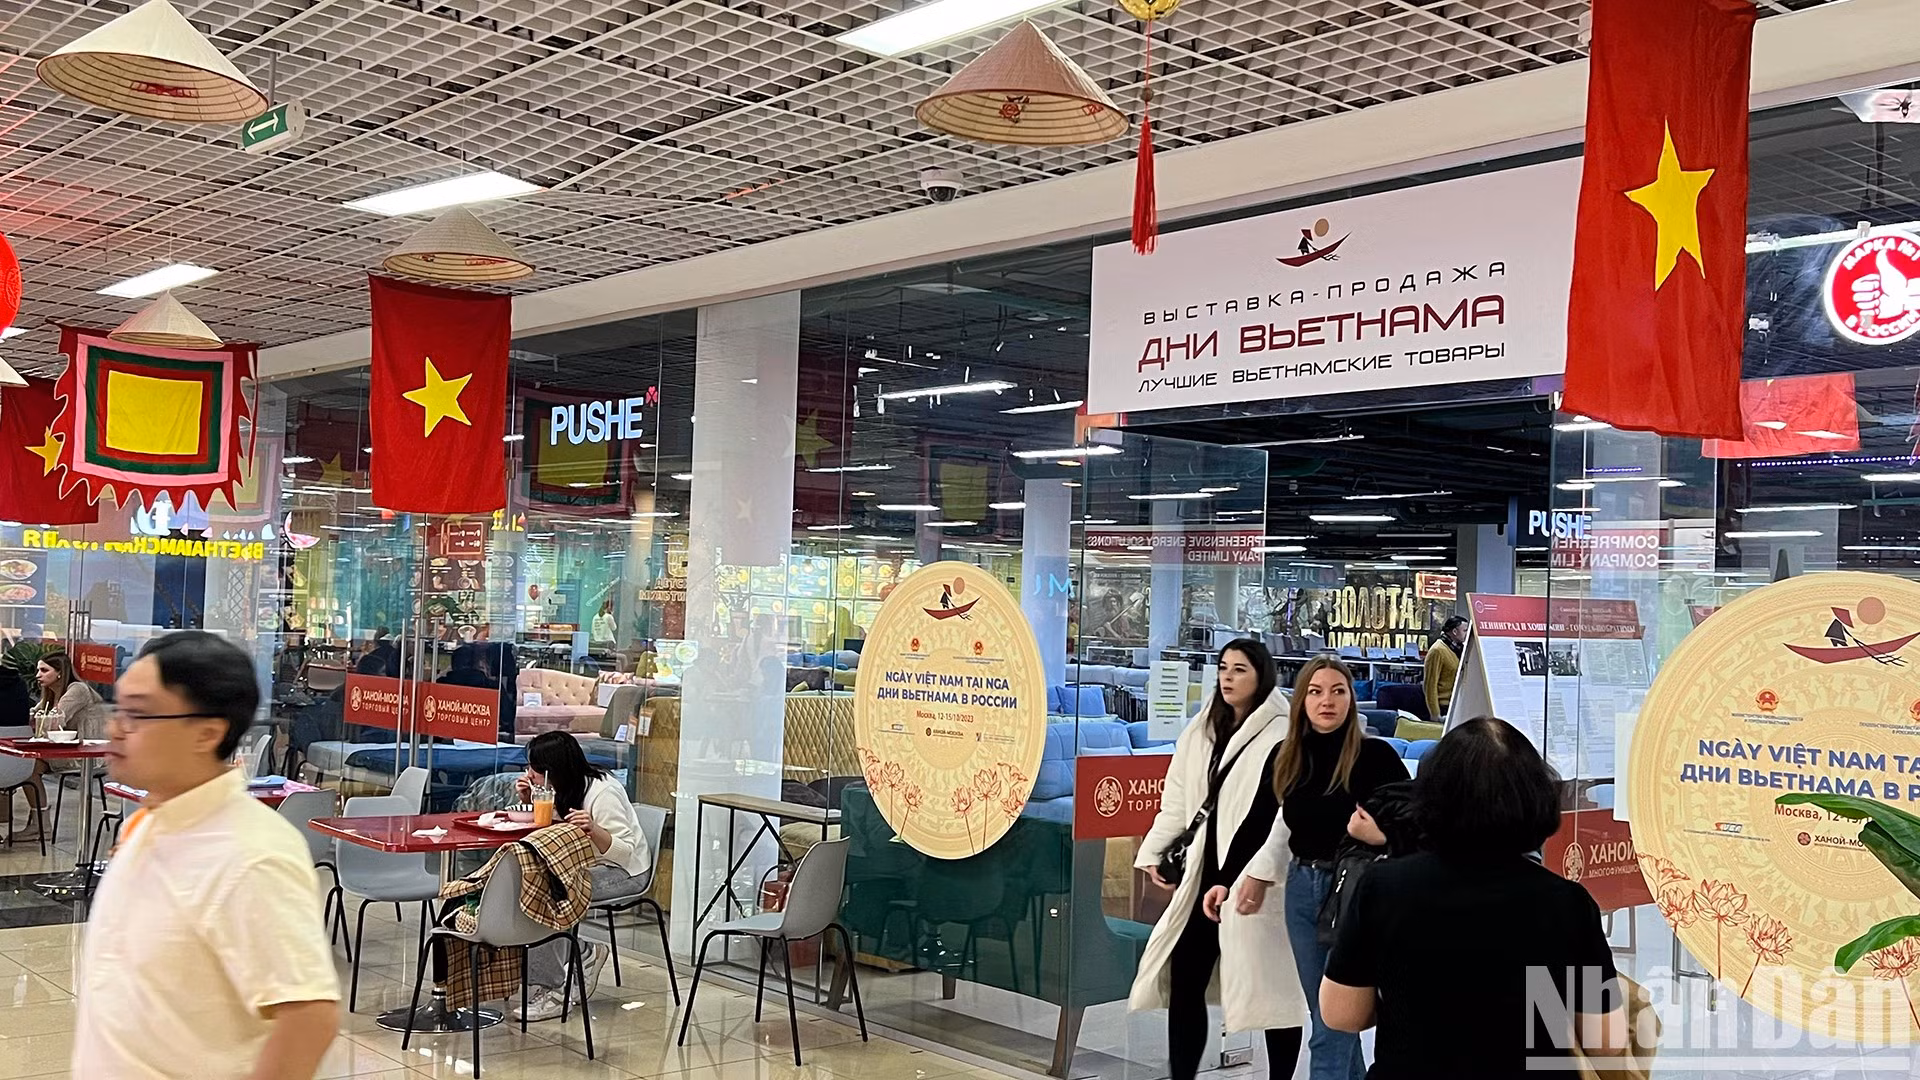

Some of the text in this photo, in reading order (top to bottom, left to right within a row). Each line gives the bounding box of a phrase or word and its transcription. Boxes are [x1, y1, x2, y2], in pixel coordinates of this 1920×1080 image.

[1842, 237, 1896, 270] МАРКА
[1143, 261, 1505, 325] ВЫСТАВКА-ПРОДАЖА
[1138, 295, 1504, 373] ДНИ ВЬЕТНАМА
[1138, 343, 1505, 393] ЛУЧШИЕ ВЬЕТНАМСКИЕ ТОВАРЫ
[550, 397, 644, 446] PUSHE
[1528, 510, 1592, 540] PUSHE
[654, 578, 687, 590] ДЕТС
[885, 669, 1010, 691] NGÀY VIỆT NAM TẠI NGA
[437, 699, 491, 716] ХАНОЙ-МОСКВА
[877, 687, 1017, 709] ДНИ ВЬЕТНАМА В РОССИИ
[437, 713, 491, 727] ТОРГОВЫЙ ЦЕНТР
[1698, 738, 1762, 760] NGÀY
[1768, 743, 1822, 769] VIỆT
[1828, 750, 1886, 771] NAM
[1680, 764, 1731, 784] ДНИ
[1738, 768, 1876, 798] ВЬЕТНАМА
[1884, 782, 1899, 800] В
[1127, 799, 1161, 811] ТОРГ
[1775, 803, 1823, 822] Москва,
